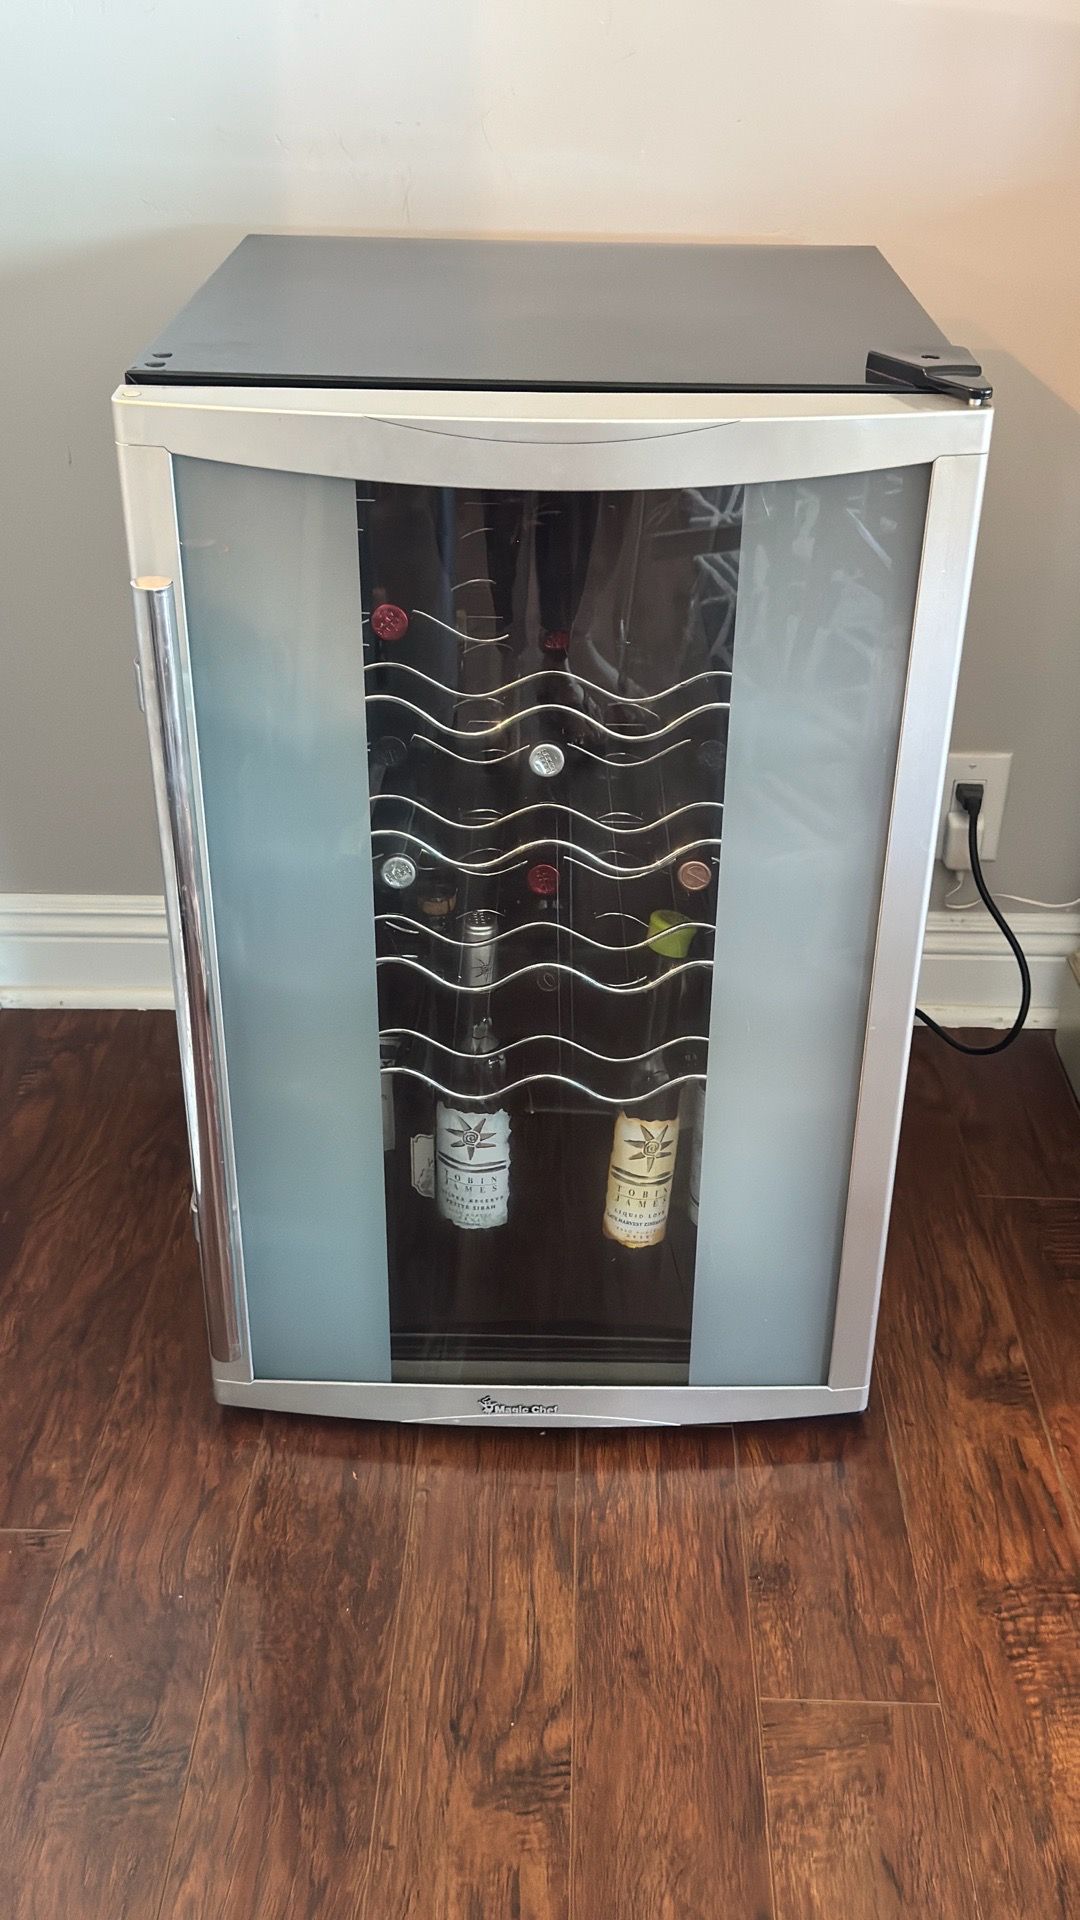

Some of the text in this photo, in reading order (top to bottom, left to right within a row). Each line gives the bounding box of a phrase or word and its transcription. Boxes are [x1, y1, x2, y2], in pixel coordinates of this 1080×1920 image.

[617, 1185, 667, 1198] TOBIN
[614, 1208, 643, 1219] LIQUID
[618, 1218, 643, 1226] HARVEST
[494, 1404, 558, 1413] Magic Chef
